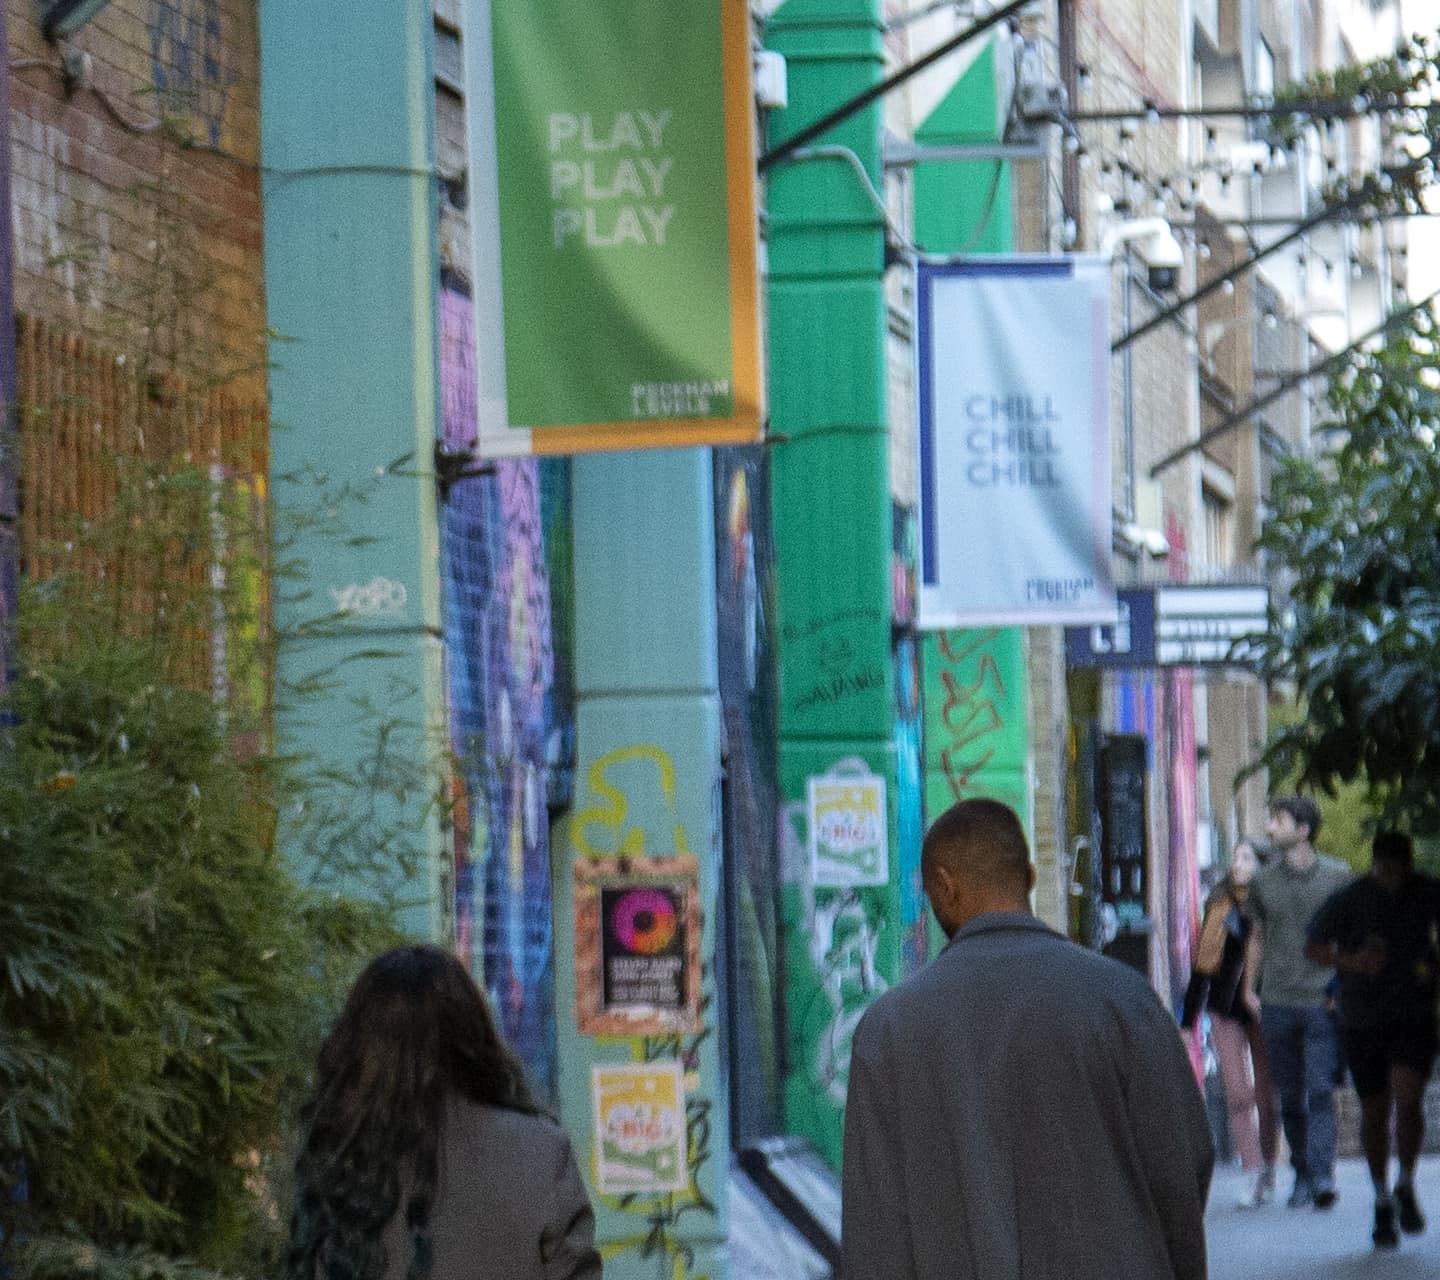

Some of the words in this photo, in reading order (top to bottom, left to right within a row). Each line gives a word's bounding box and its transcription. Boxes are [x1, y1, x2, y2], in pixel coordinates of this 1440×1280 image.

[547, 110, 672, 152] PLAY
[549, 157, 675, 201] PLAY
[551, 204, 676, 249] PLAY
[965, 394, 1062, 422] CHILL
[966, 427, 1063, 456] CHILL
[967, 459, 1063, 489] CHILL
